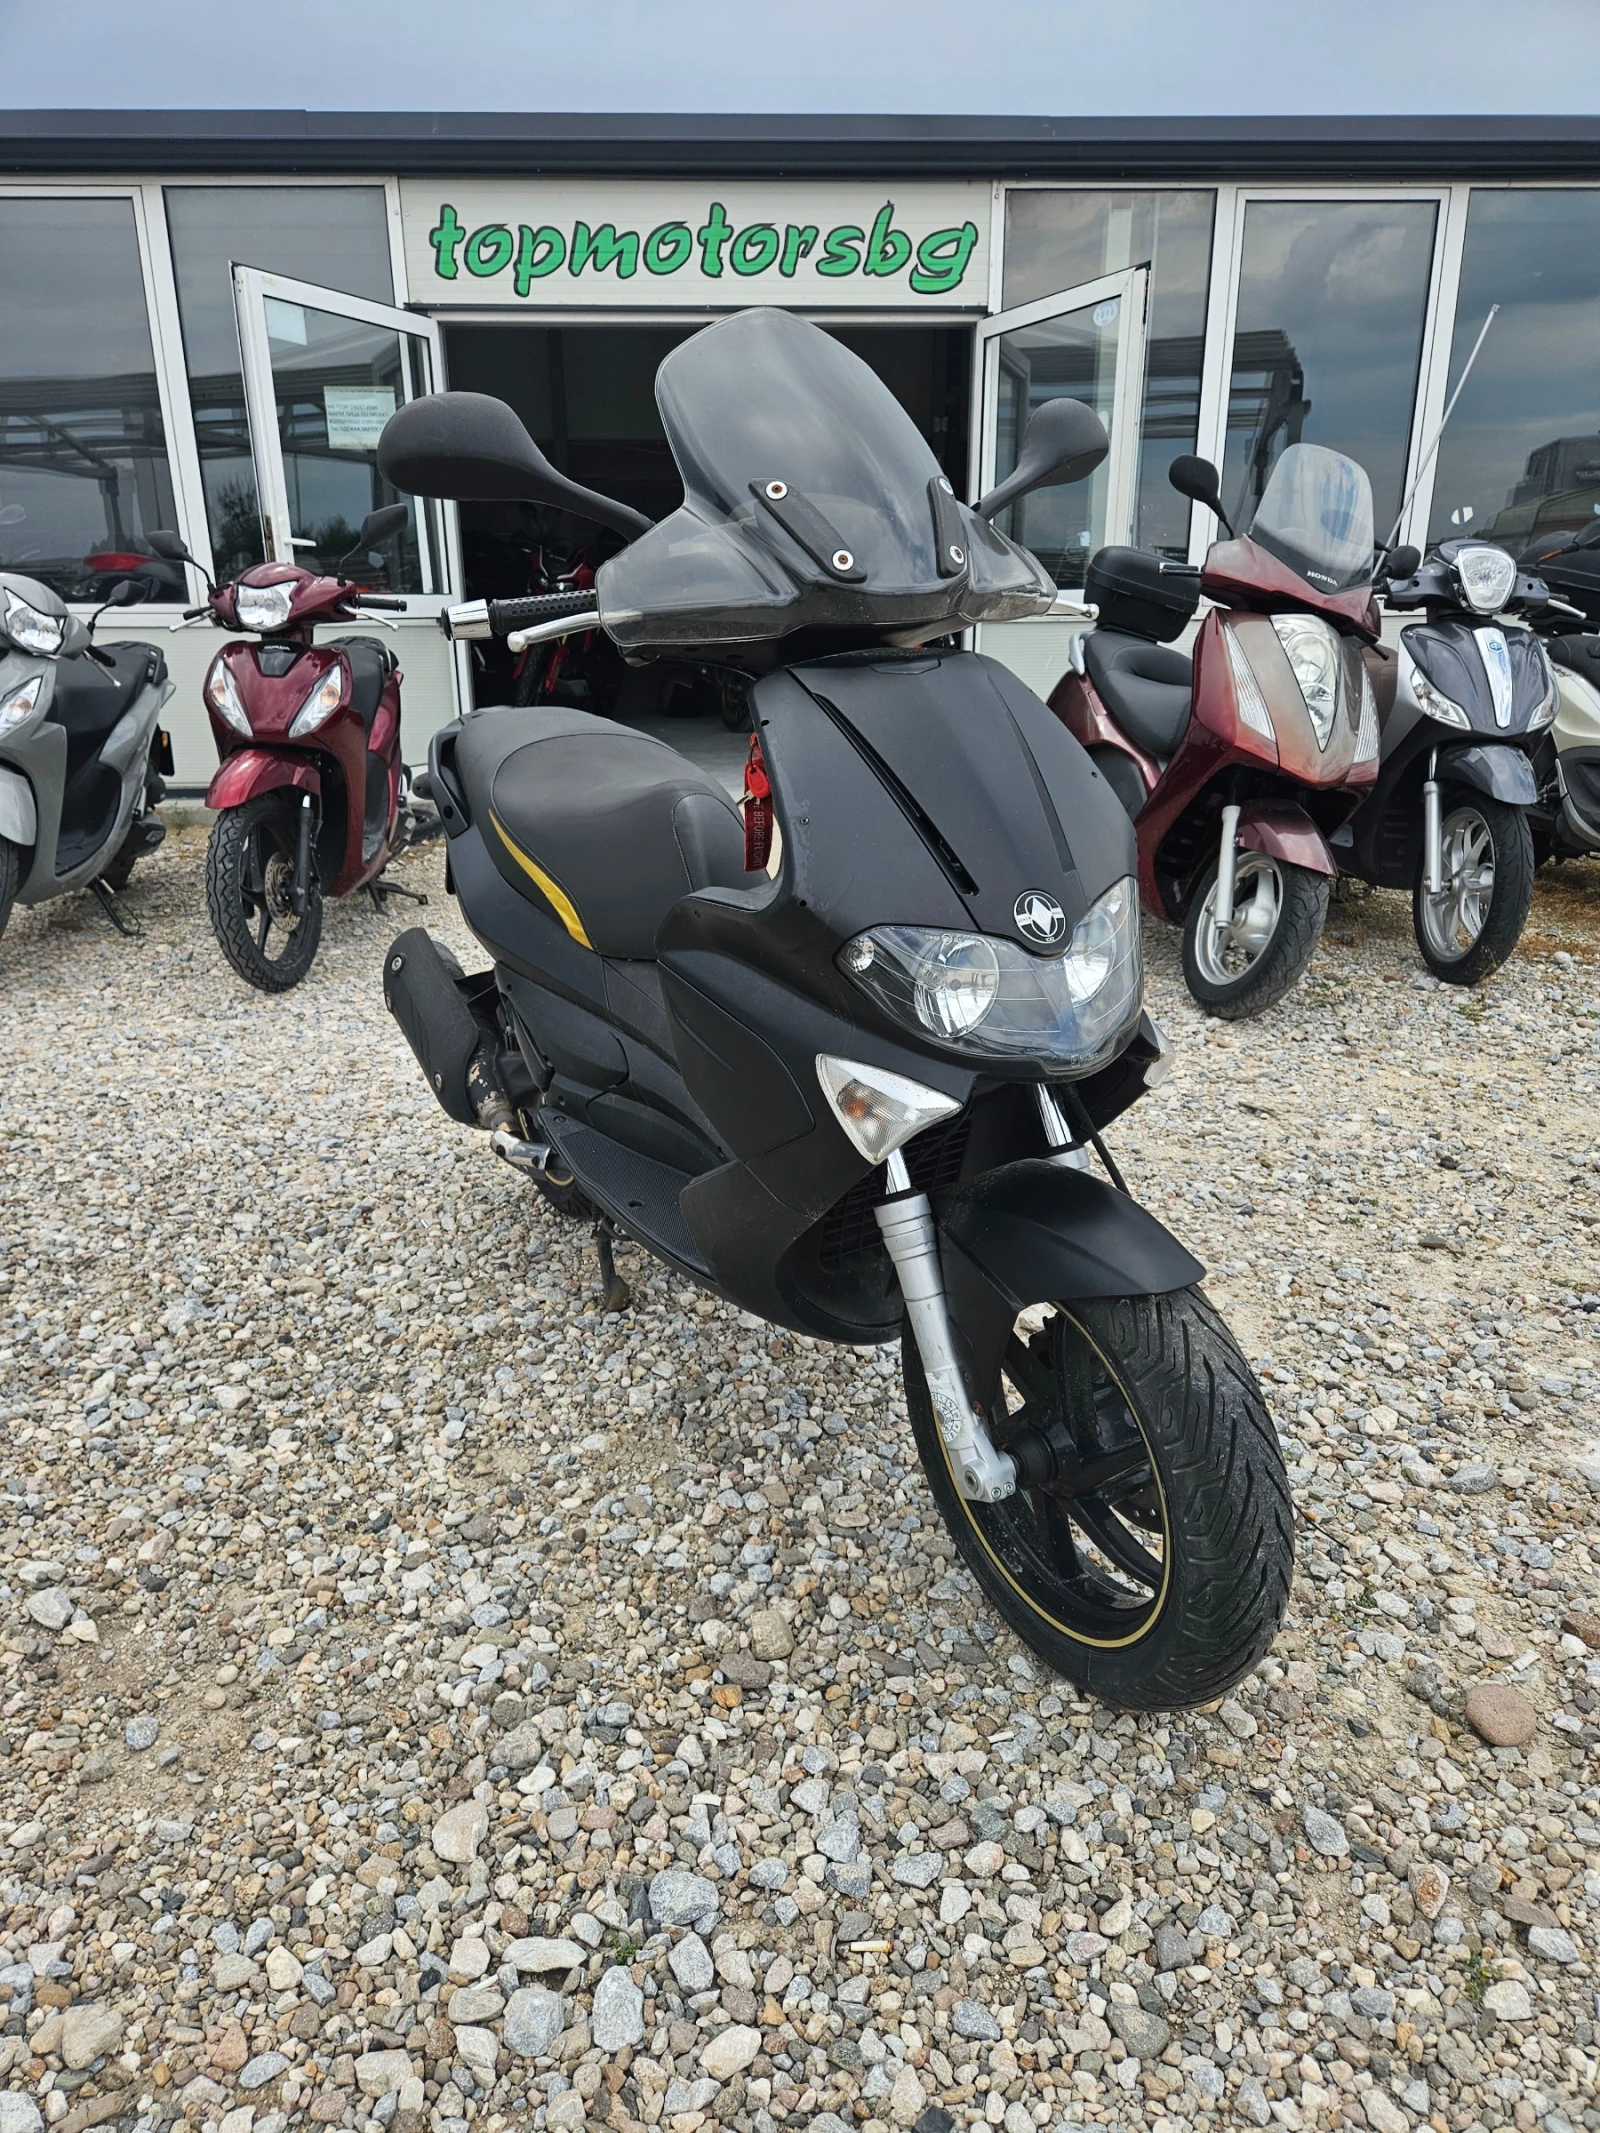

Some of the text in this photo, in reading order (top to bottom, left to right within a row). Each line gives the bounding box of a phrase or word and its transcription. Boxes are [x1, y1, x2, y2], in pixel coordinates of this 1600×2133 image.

[429, 200, 978, 297] topmotorsbg
[1306, 570, 1338, 587] HONDA
[753, 811, 765, 841] BEFORE
